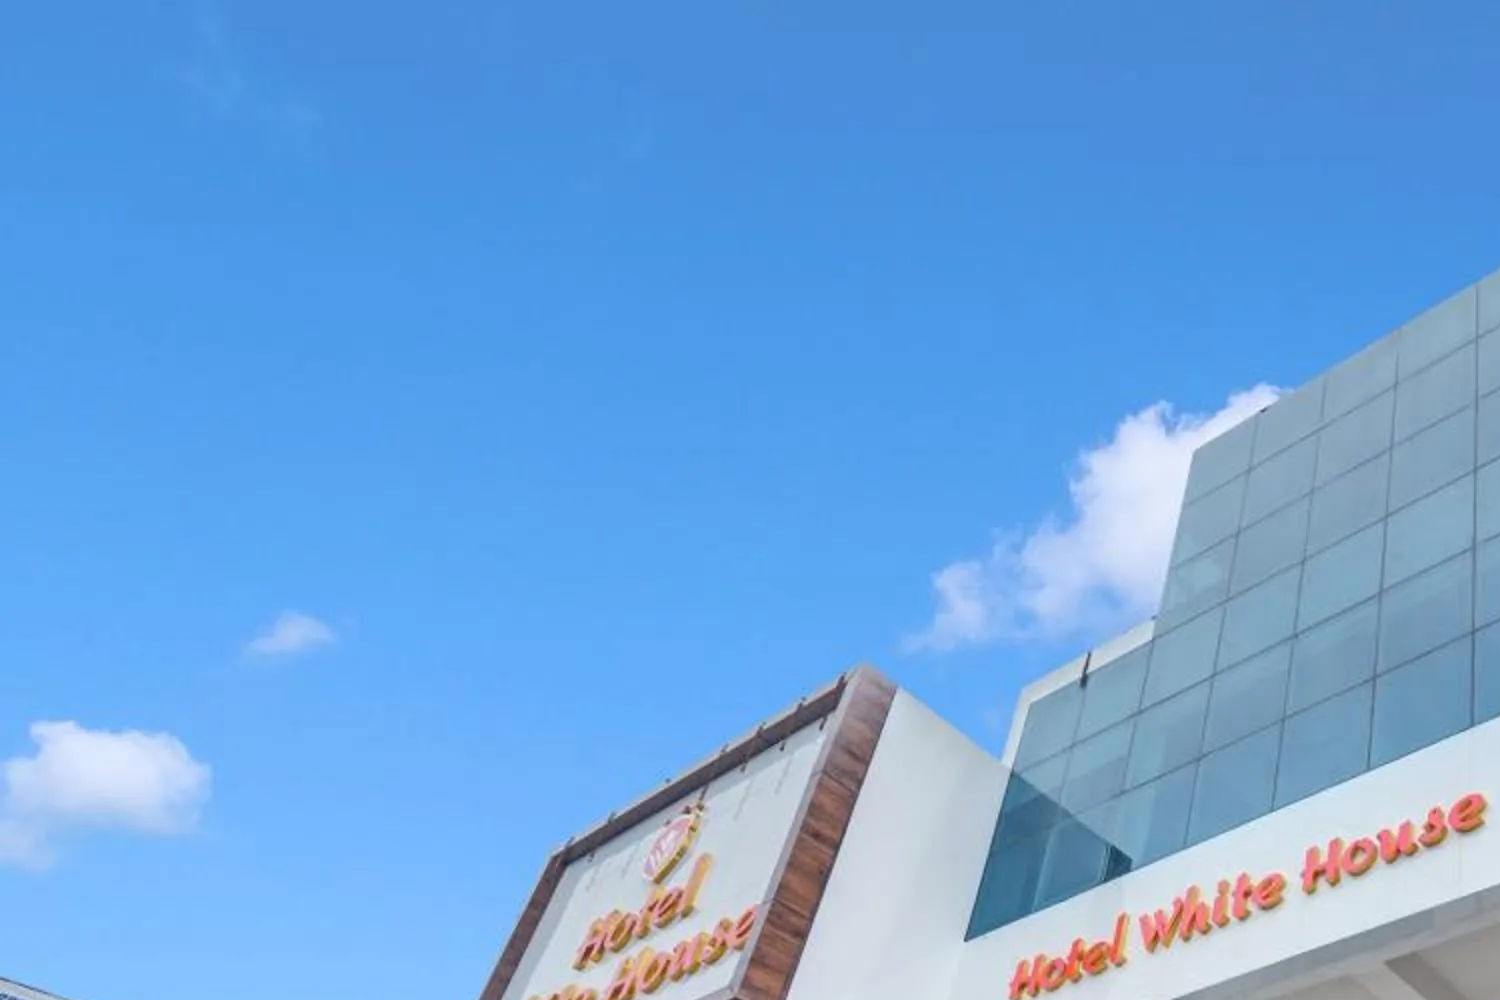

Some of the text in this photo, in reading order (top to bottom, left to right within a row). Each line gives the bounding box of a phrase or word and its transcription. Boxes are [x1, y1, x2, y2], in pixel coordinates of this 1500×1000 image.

[572, 850, 714, 971] Hotel
[1139, 871, 1285, 954] White
[1301, 791, 1489, 895] House
